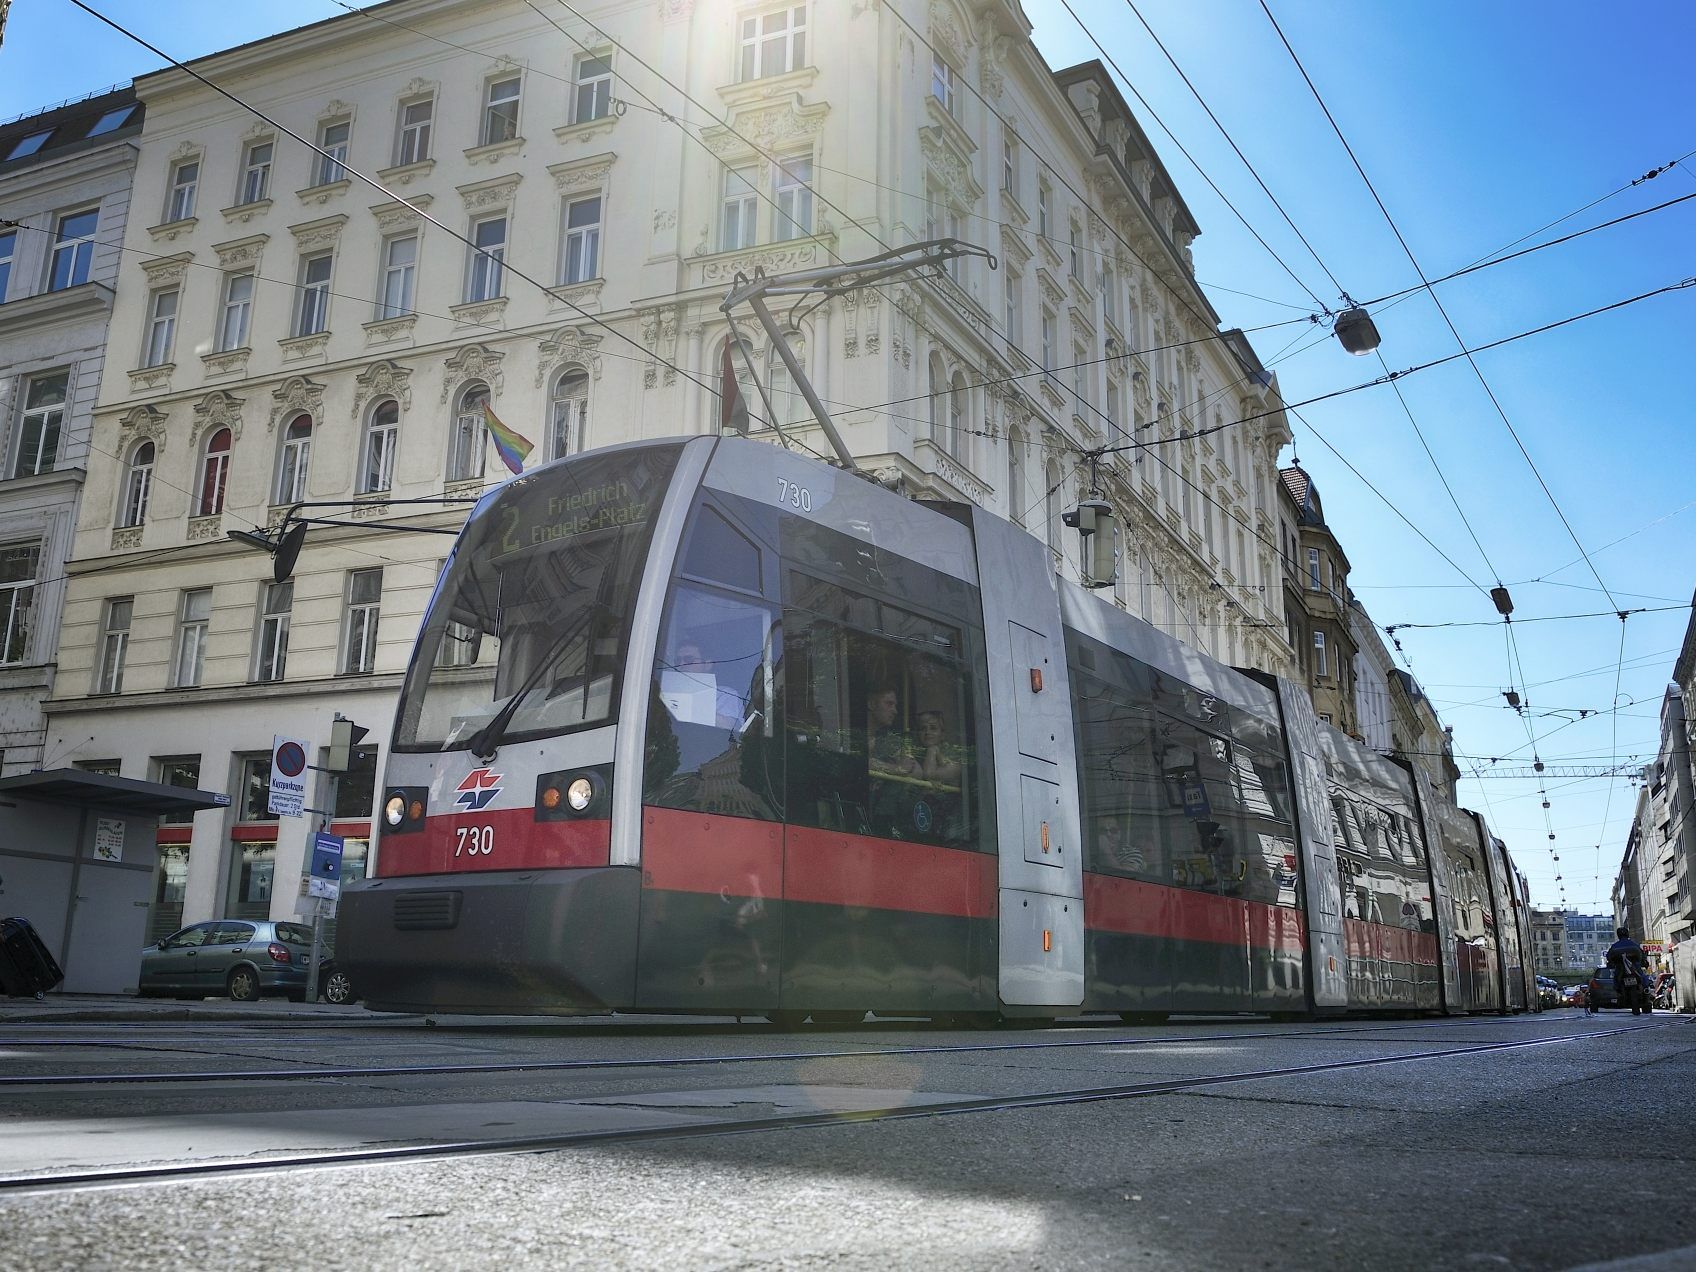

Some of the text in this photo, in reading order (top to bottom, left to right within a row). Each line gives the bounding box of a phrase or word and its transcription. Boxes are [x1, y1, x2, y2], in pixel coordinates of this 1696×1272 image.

[548, 480, 628, 516] Friedrich
[777, 476, 812, 513] 730
[502, 506, 520, 550] 2
[455, 825, 495, 857] 730
